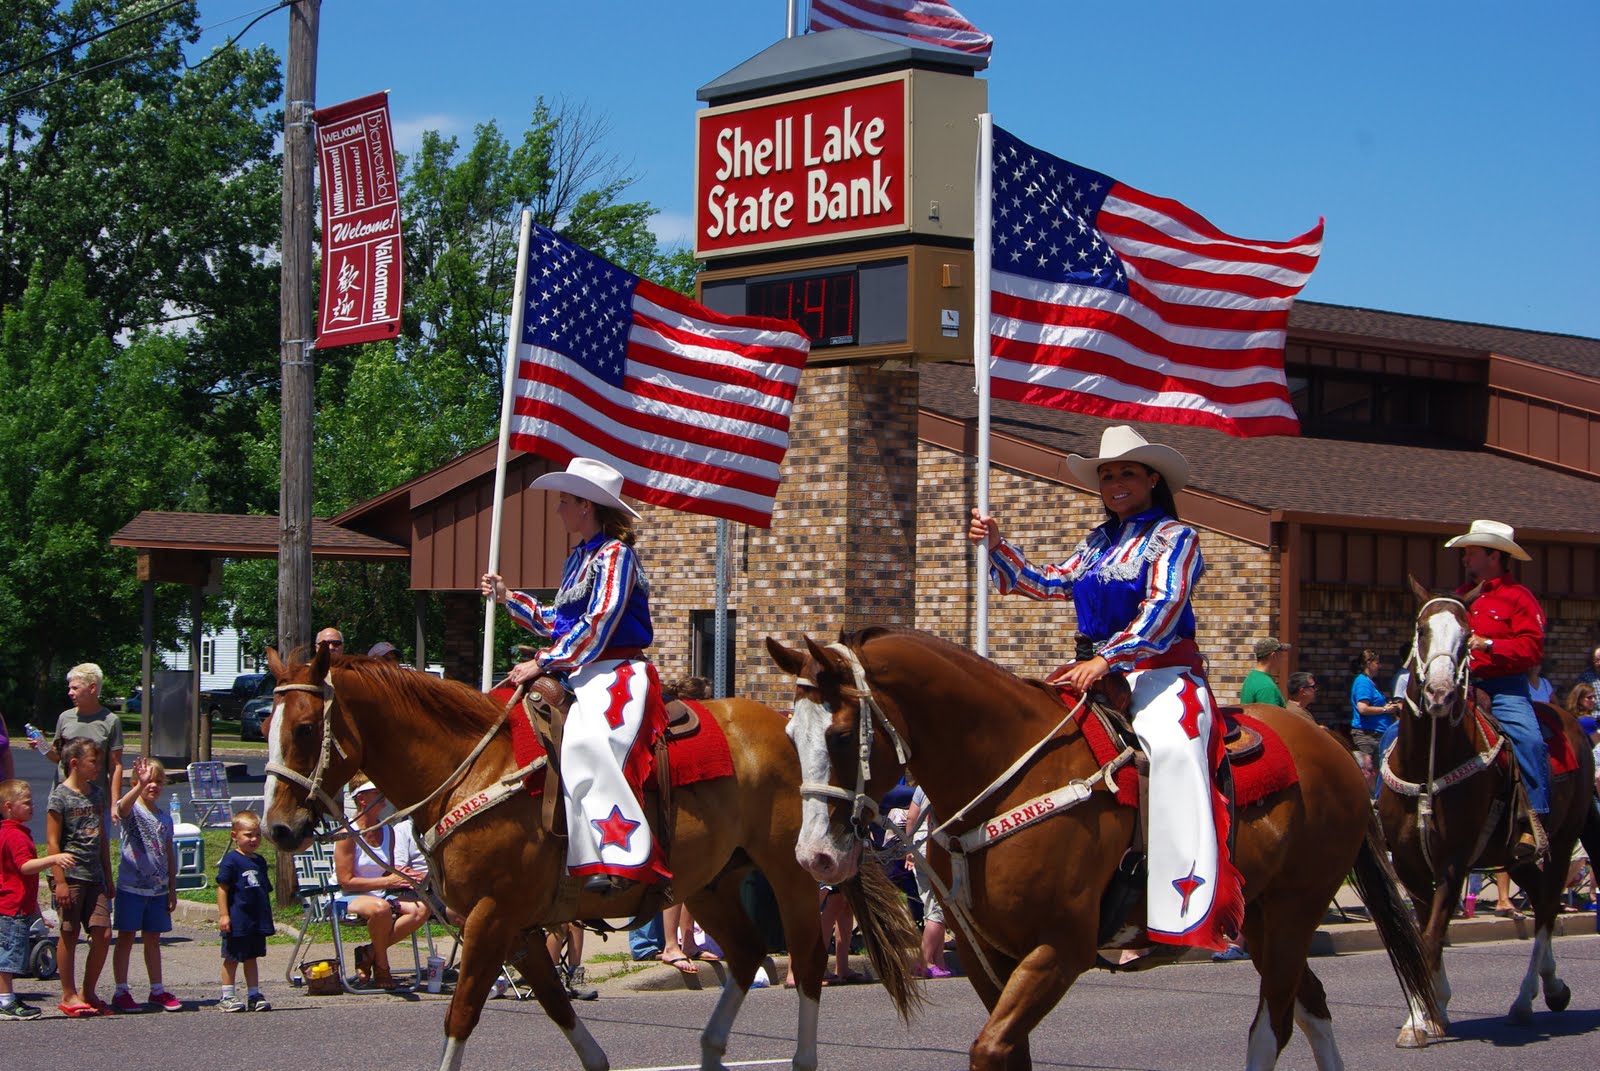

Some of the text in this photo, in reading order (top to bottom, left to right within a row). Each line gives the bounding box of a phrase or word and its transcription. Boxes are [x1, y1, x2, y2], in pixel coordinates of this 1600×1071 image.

[322, 123, 363, 143] WELKOM!
[367, 113, 393, 202] Bienvenido!
[716, 105, 885, 181] Shell Lake
[329, 148, 345, 216] Willkommen!
[349, 146, 366, 207] Bienvenue!
[706, 160, 893, 239] State Bank
[331, 208, 397, 243] Welcome!
[1443, 760, 1478, 785] BARNES
[435, 792, 489, 837] BARNES
[986, 797, 1055, 839] BARNES
